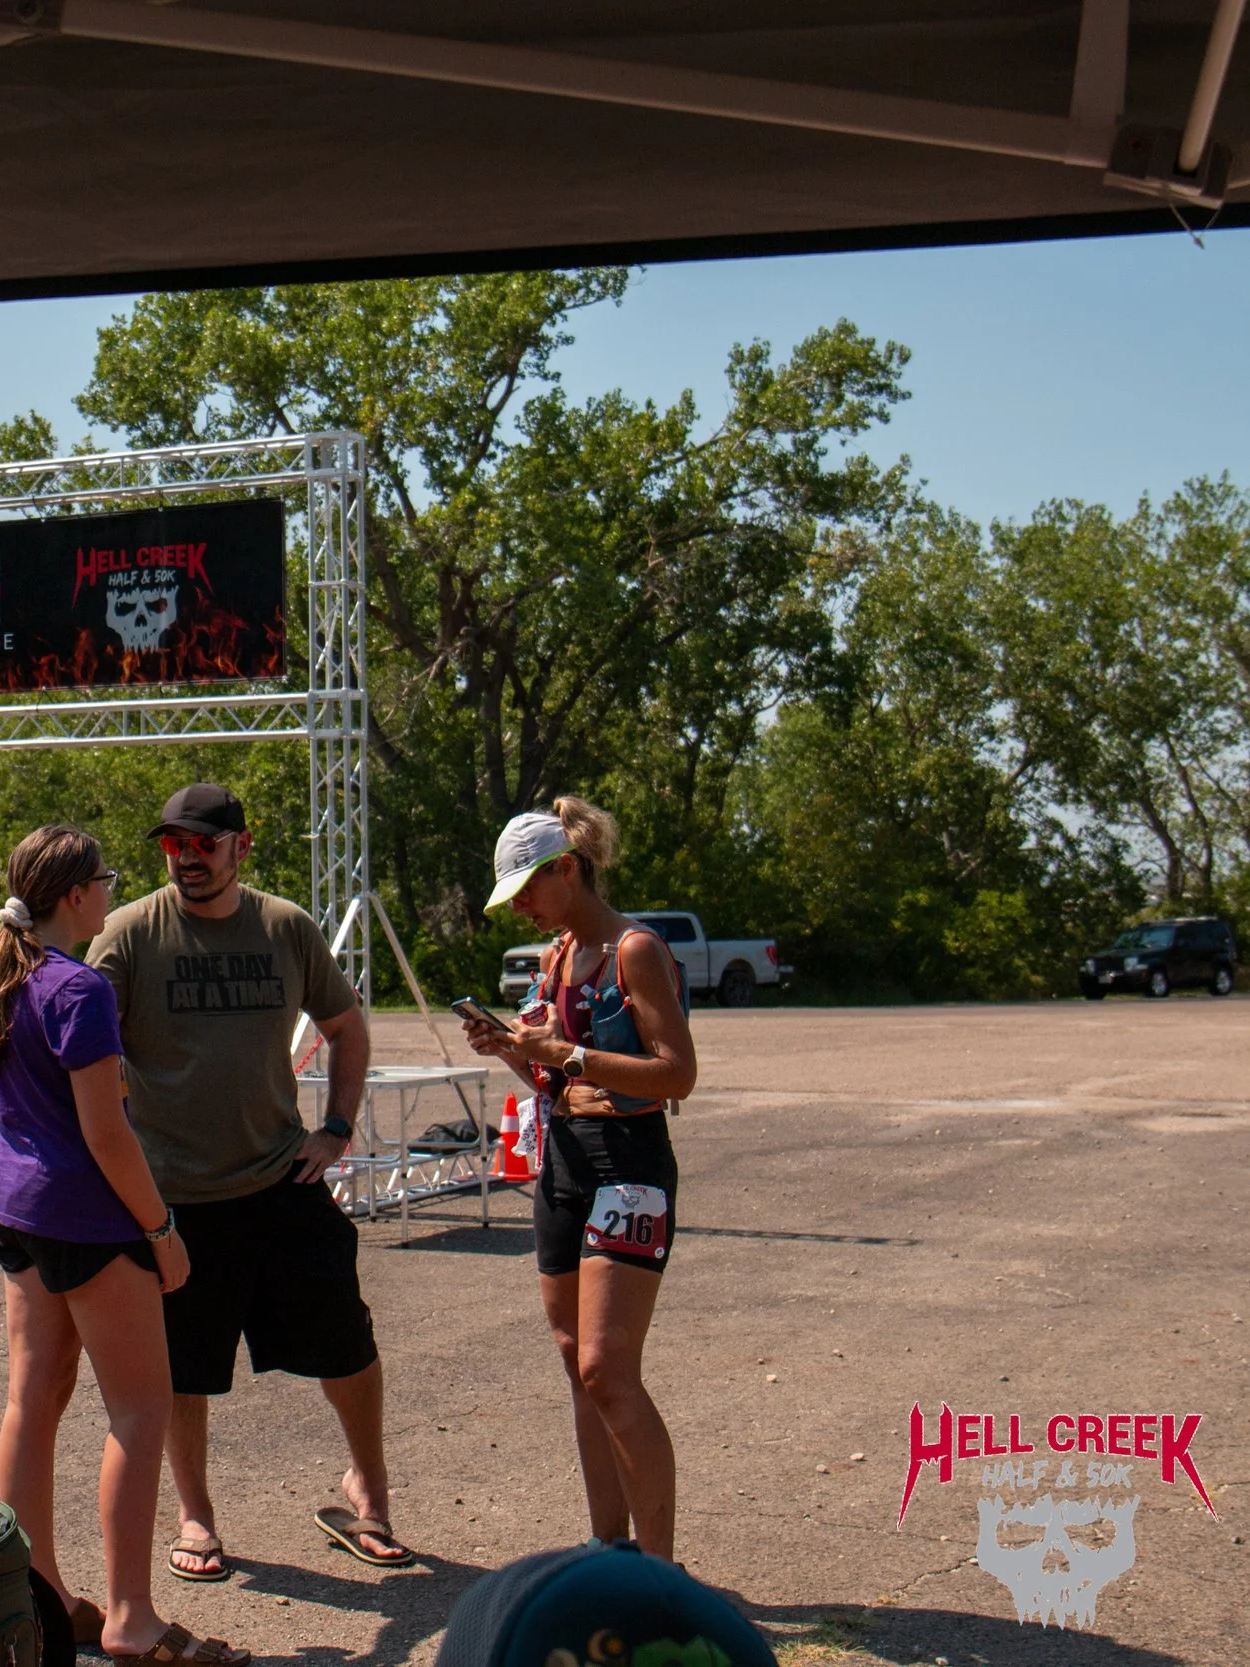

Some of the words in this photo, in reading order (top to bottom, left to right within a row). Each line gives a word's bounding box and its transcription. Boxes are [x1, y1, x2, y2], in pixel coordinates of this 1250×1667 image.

[72, 546, 132, 608] HELL
[136, 542, 214, 596] CREEK
[108, 570, 138, 586] HALF
[140, 569, 151, 584] &
[154, 569, 176, 583] 50K
[174, 954, 224, 980] ONE
[226, 953, 273, 979] DAY
[172, 981, 199, 1009] AT
[205, 981, 223, 1008] A
[224, 979, 285, 1008] TIME
[603, 1209, 654, 1245] 216
